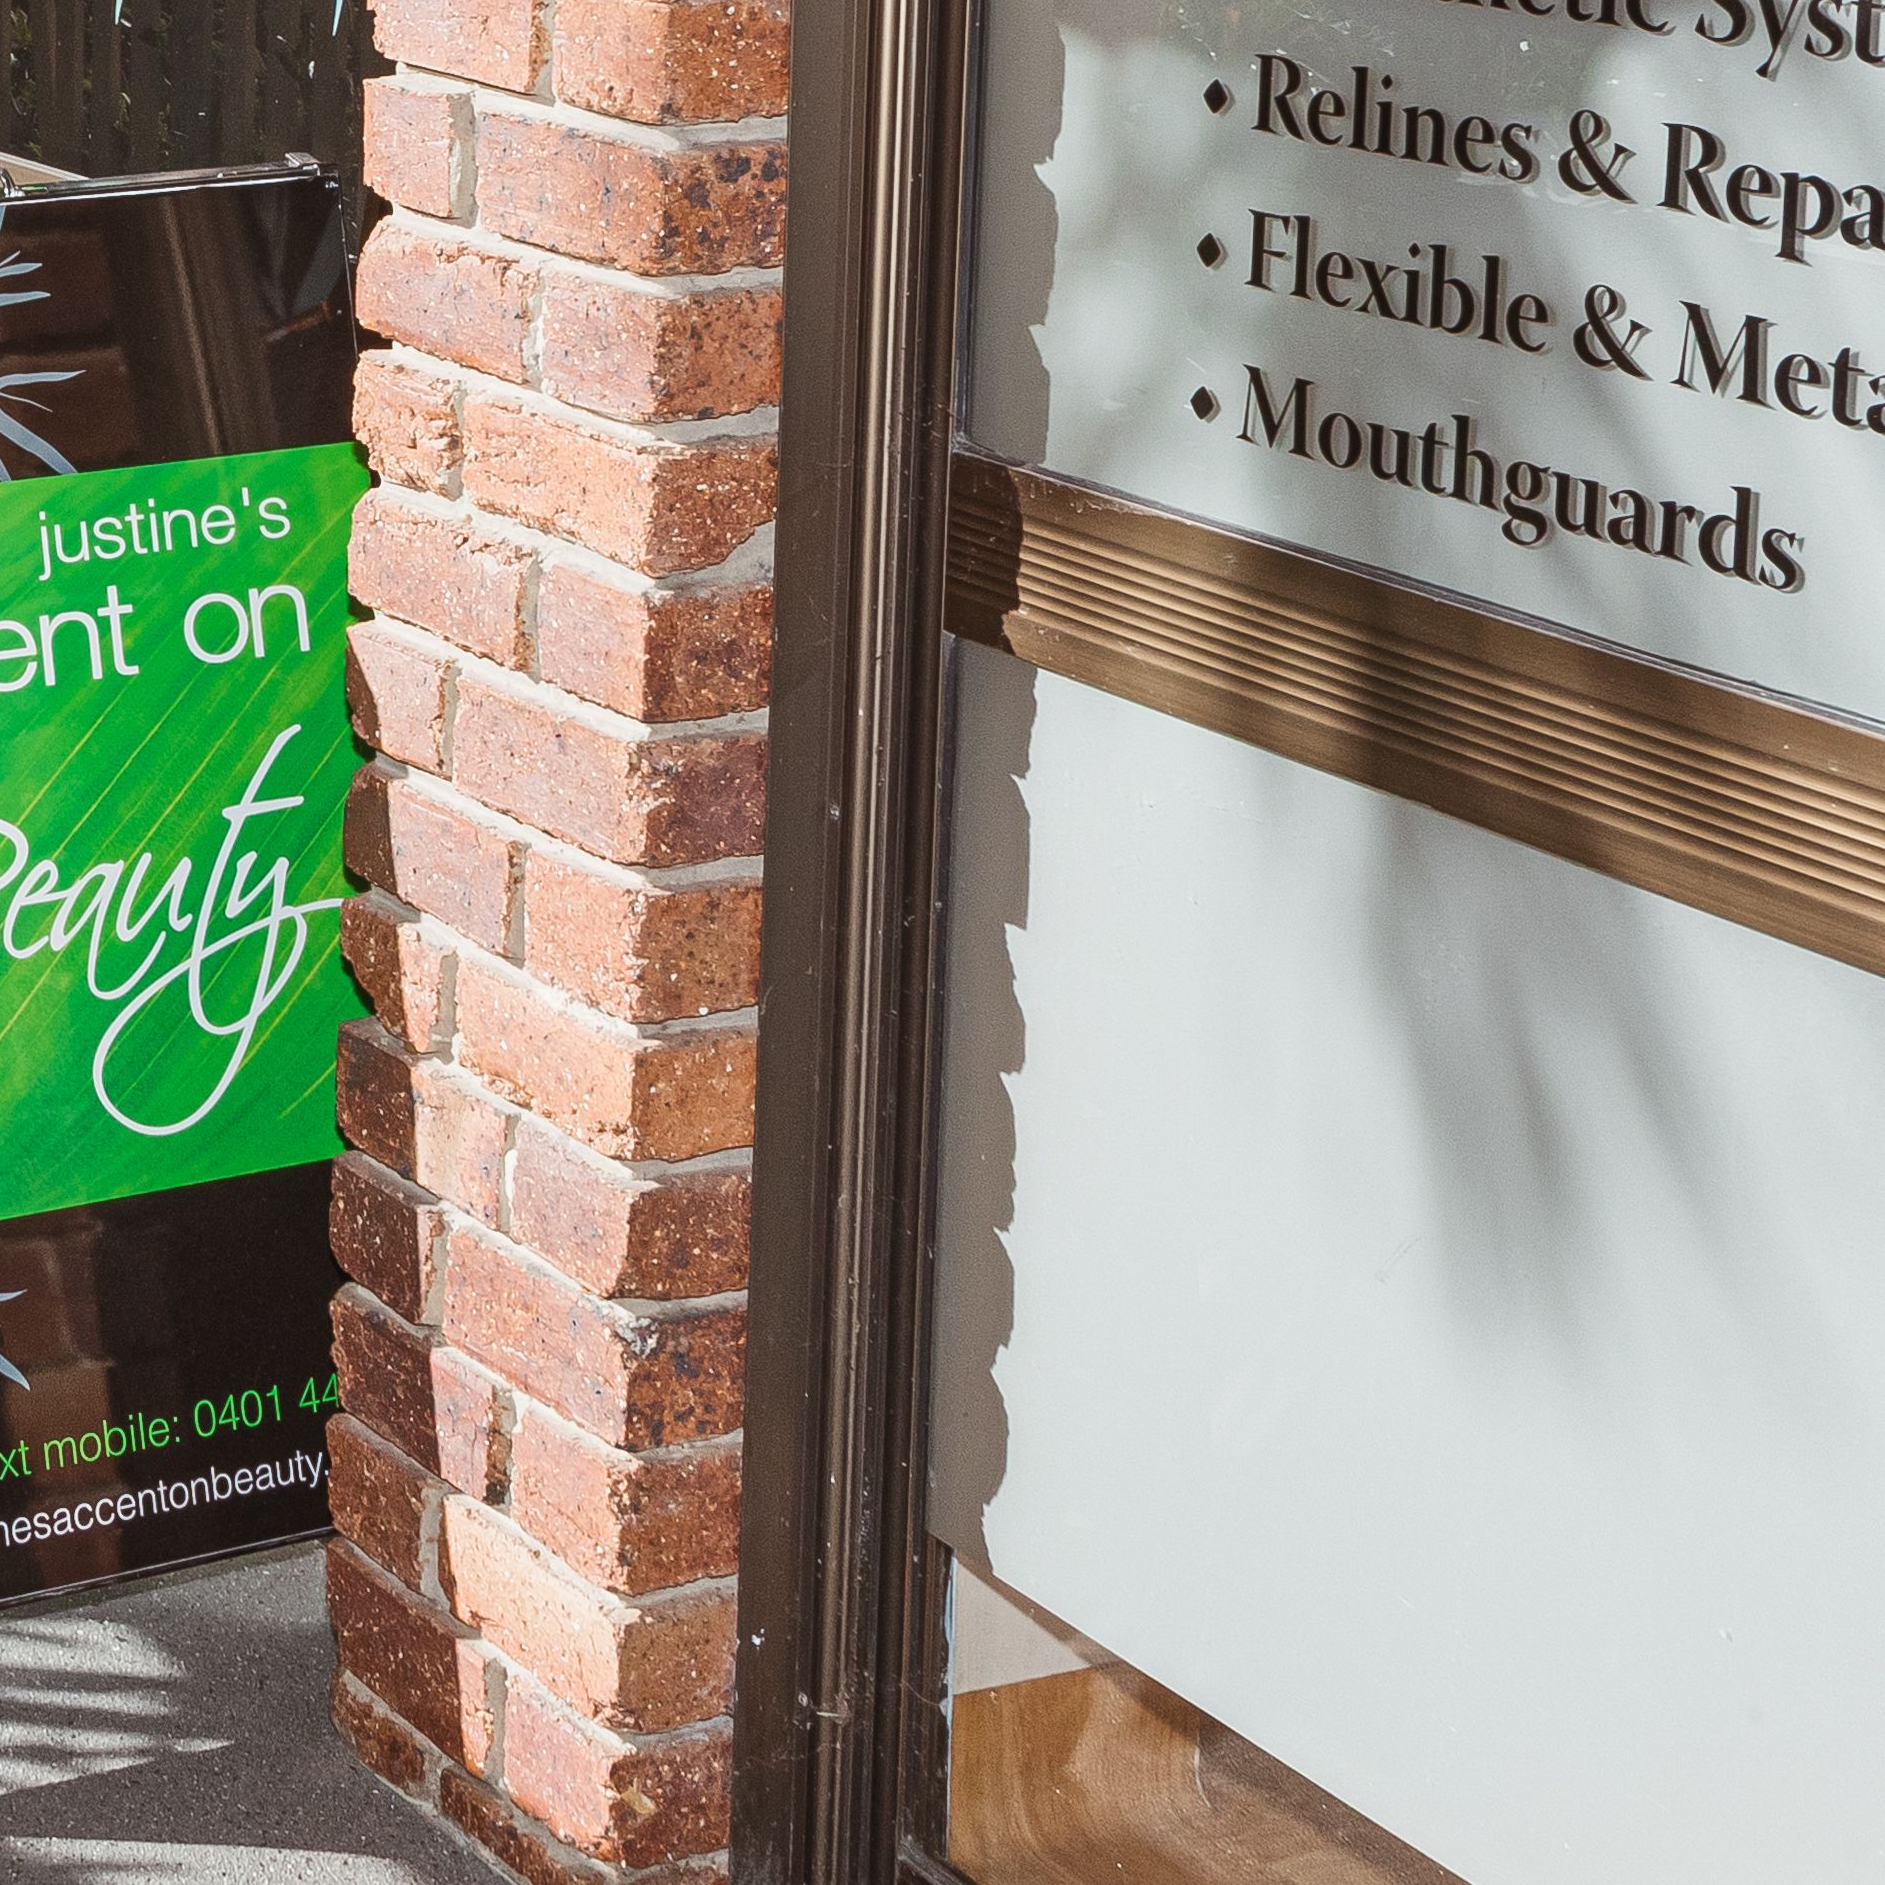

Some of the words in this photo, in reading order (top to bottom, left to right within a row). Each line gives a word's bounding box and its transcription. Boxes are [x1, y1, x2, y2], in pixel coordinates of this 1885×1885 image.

[1251, 54, 1534, 181] Relines
[1557, 110, 1635, 201] &
[1245, 209, 1546, 352] Flexible
[1572, 284, 1651, 379] &
[38, 487, 292, 581] justine's
[1237, 365, 1804, 592] Mouthguards
[183, 583, 309, 665] on
[43, 1412, 181, 1472] mobile:
[194, 1384, 281, 1437] 0401
